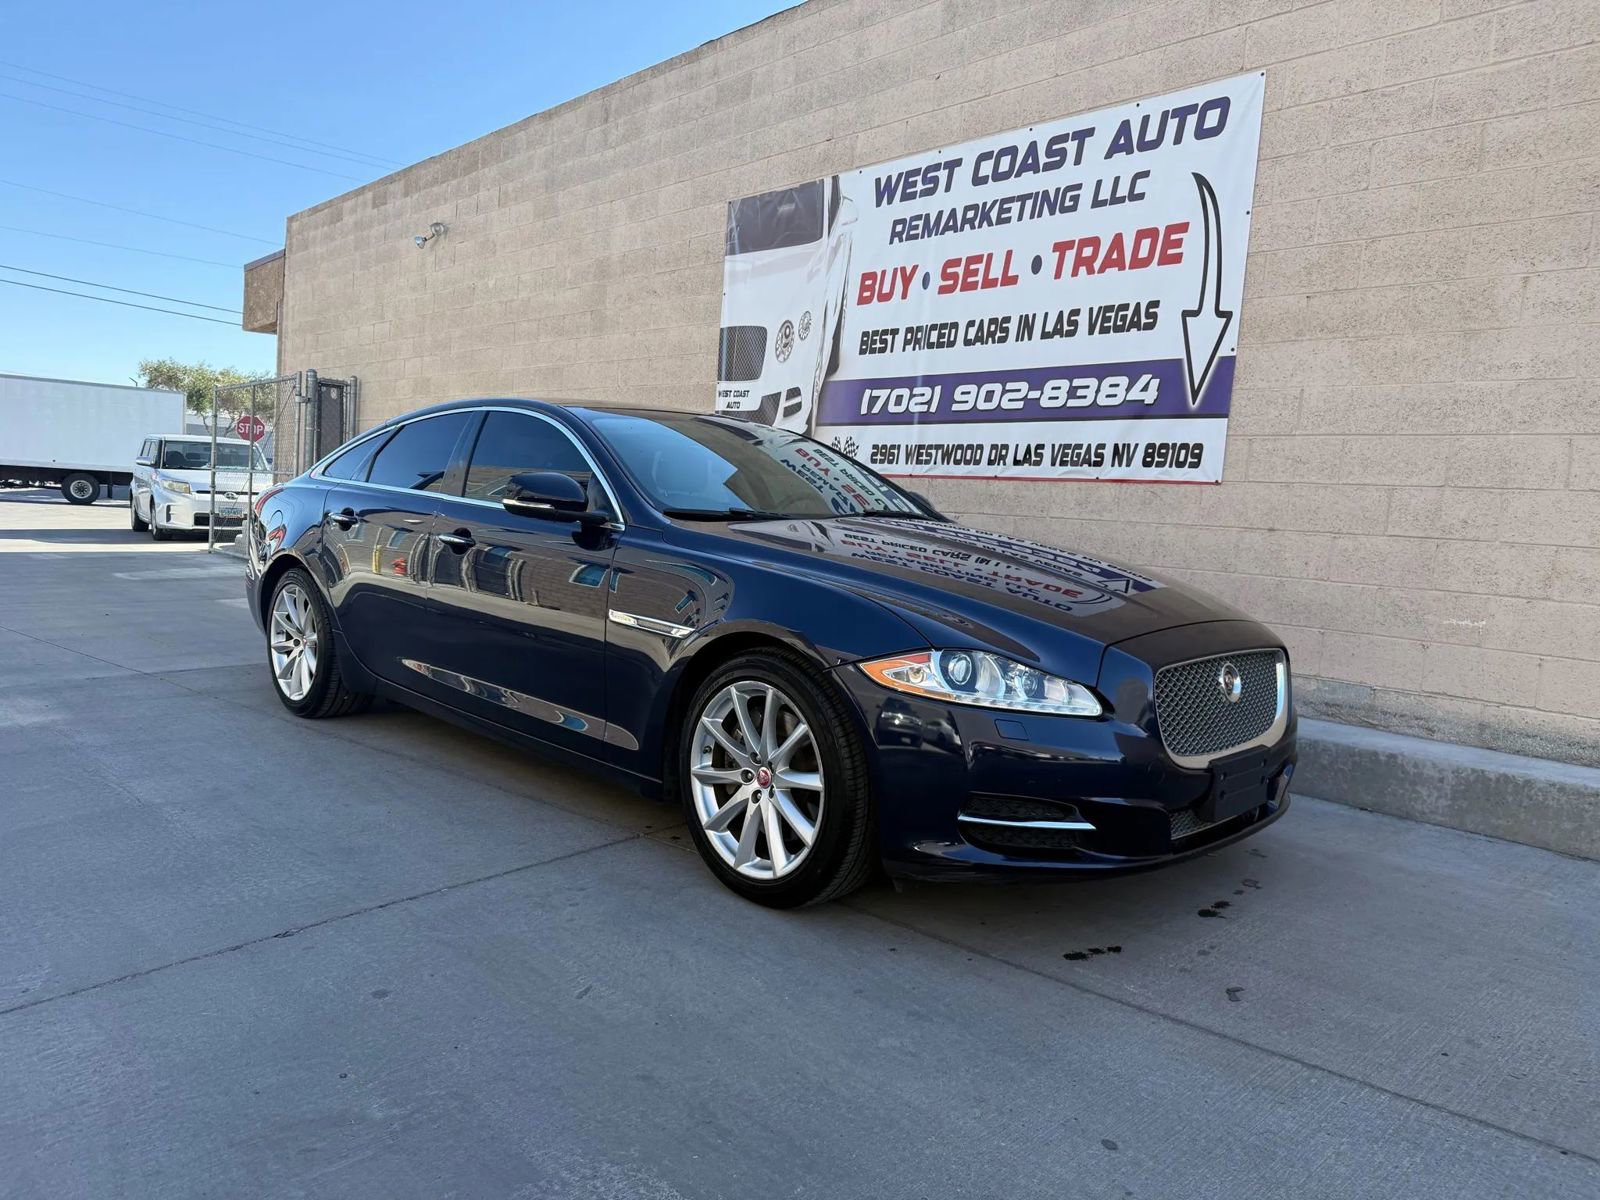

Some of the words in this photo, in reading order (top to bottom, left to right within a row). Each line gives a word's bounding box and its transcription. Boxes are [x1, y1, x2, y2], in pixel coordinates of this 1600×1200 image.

[874, 157, 963, 208] WEST
[971, 127, 1096, 187] COAST
[1103, 96, 1231, 160] AUTO
[889, 182, 1083, 245] REMARKETING
[1090, 169, 1151, 209] LLC
[857, 264, 919, 306] BUY
[937, 249, 1019, 295] SELL
[1052, 221, 1190, 280] TRADE
[858, 328, 900, 356] BEST
[902, 321, 960, 352] PRICED
[963, 315, 1012, 347] CARS
[1015, 312, 1037, 342] IN
[1040, 308, 1081, 340] LAS
[1087, 299, 1161, 336] VEGAS
[718, 389, 732, 398] WEST
[733, 389, 750, 398] COAST
[726, 401, 741, 409] AUTO
[951, 373, 1161, 411] 902-8384
[870, 444, 901, 465] 2961
[904, 443, 984, 466] WESTWOOD
[987, 443, 1009, 466] DR
[1012, 443, 1045, 467] LAS
[1050, 443, 1106, 467] VEGAS
[1110, 442, 1139, 468] NV
[1142, 442, 1204, 469] 89109
